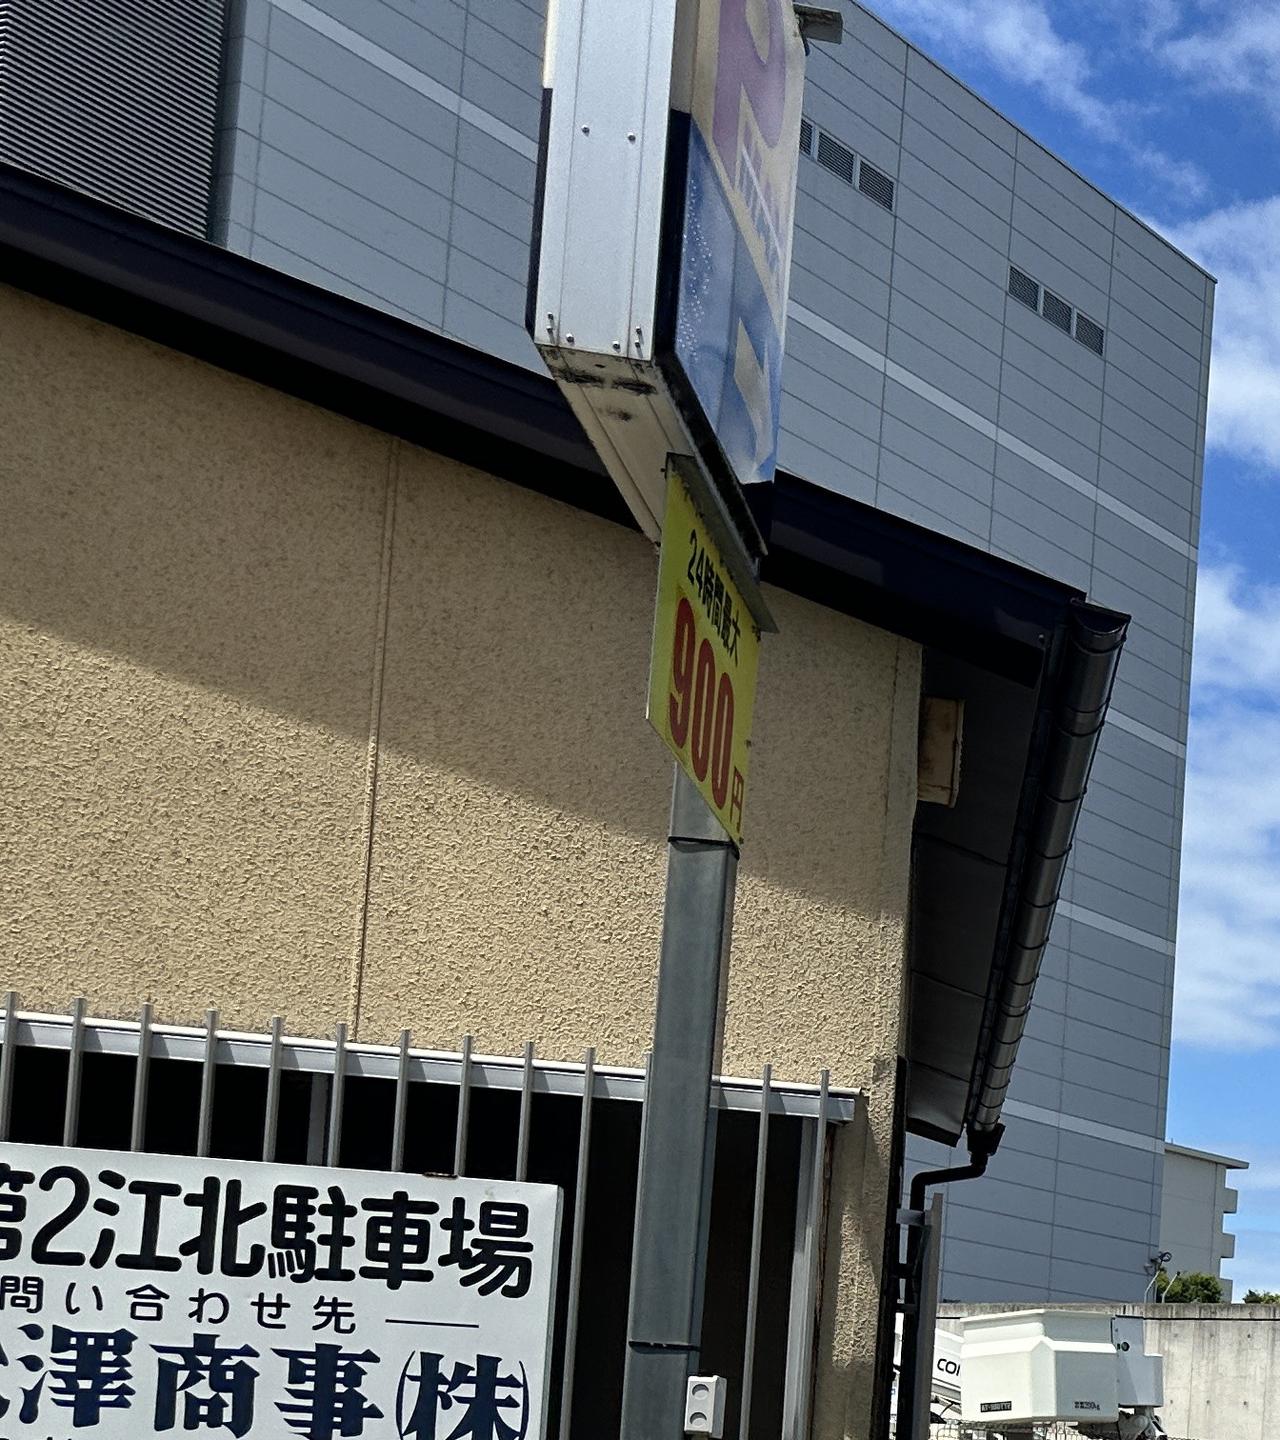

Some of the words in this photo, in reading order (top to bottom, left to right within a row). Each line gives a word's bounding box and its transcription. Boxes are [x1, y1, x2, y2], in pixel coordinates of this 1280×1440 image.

[0, 1275, 357, 1335] 問い合わせ先
